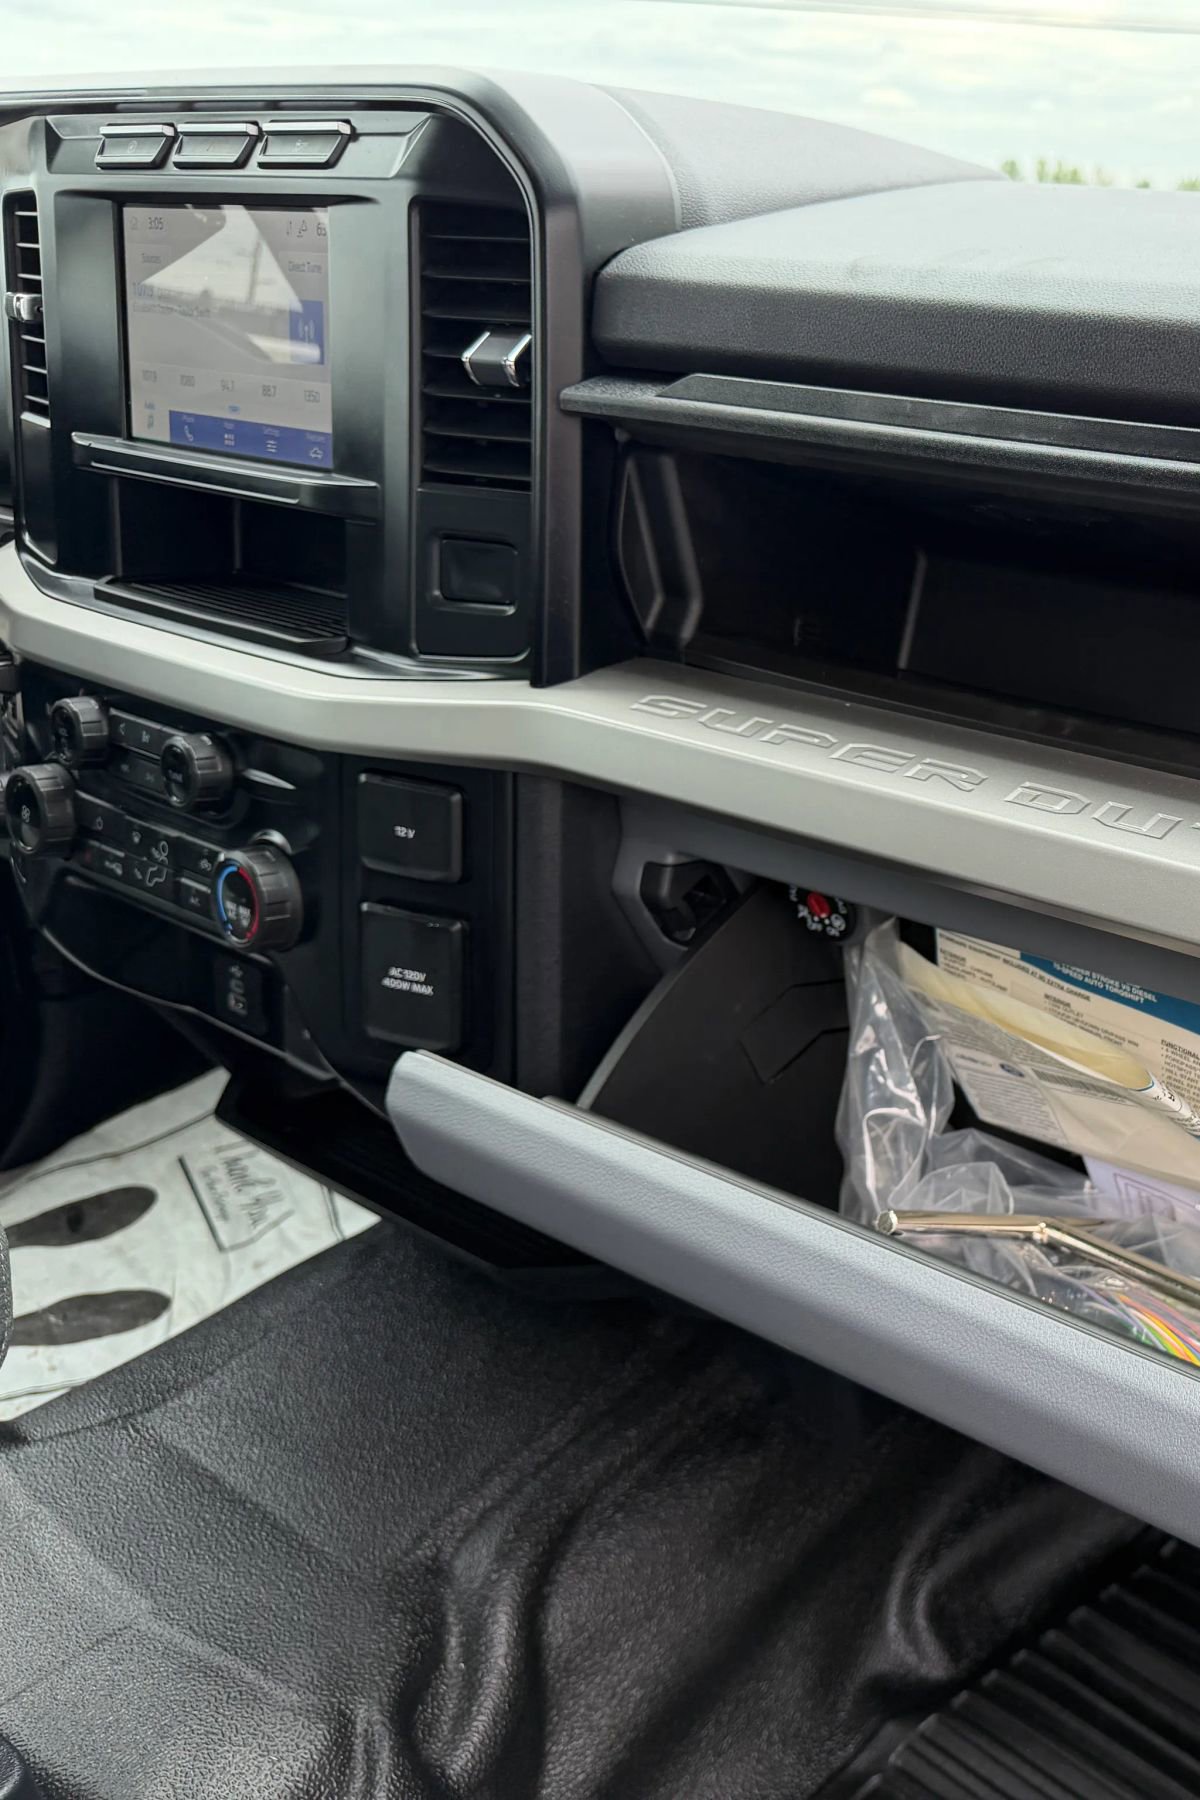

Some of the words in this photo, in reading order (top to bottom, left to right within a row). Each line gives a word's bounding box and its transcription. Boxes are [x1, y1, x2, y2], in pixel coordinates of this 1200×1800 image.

[629, 694, 989, 793] SUPER
[381, 976, 410, 991] 400W
[411, 981, 434, 997] MAX
[1084, 976, 1103, 988] AUTO
[1065, 986, 1090, 1003] CHARGE
[1132, 987, 1157, 1002] DIESEL
